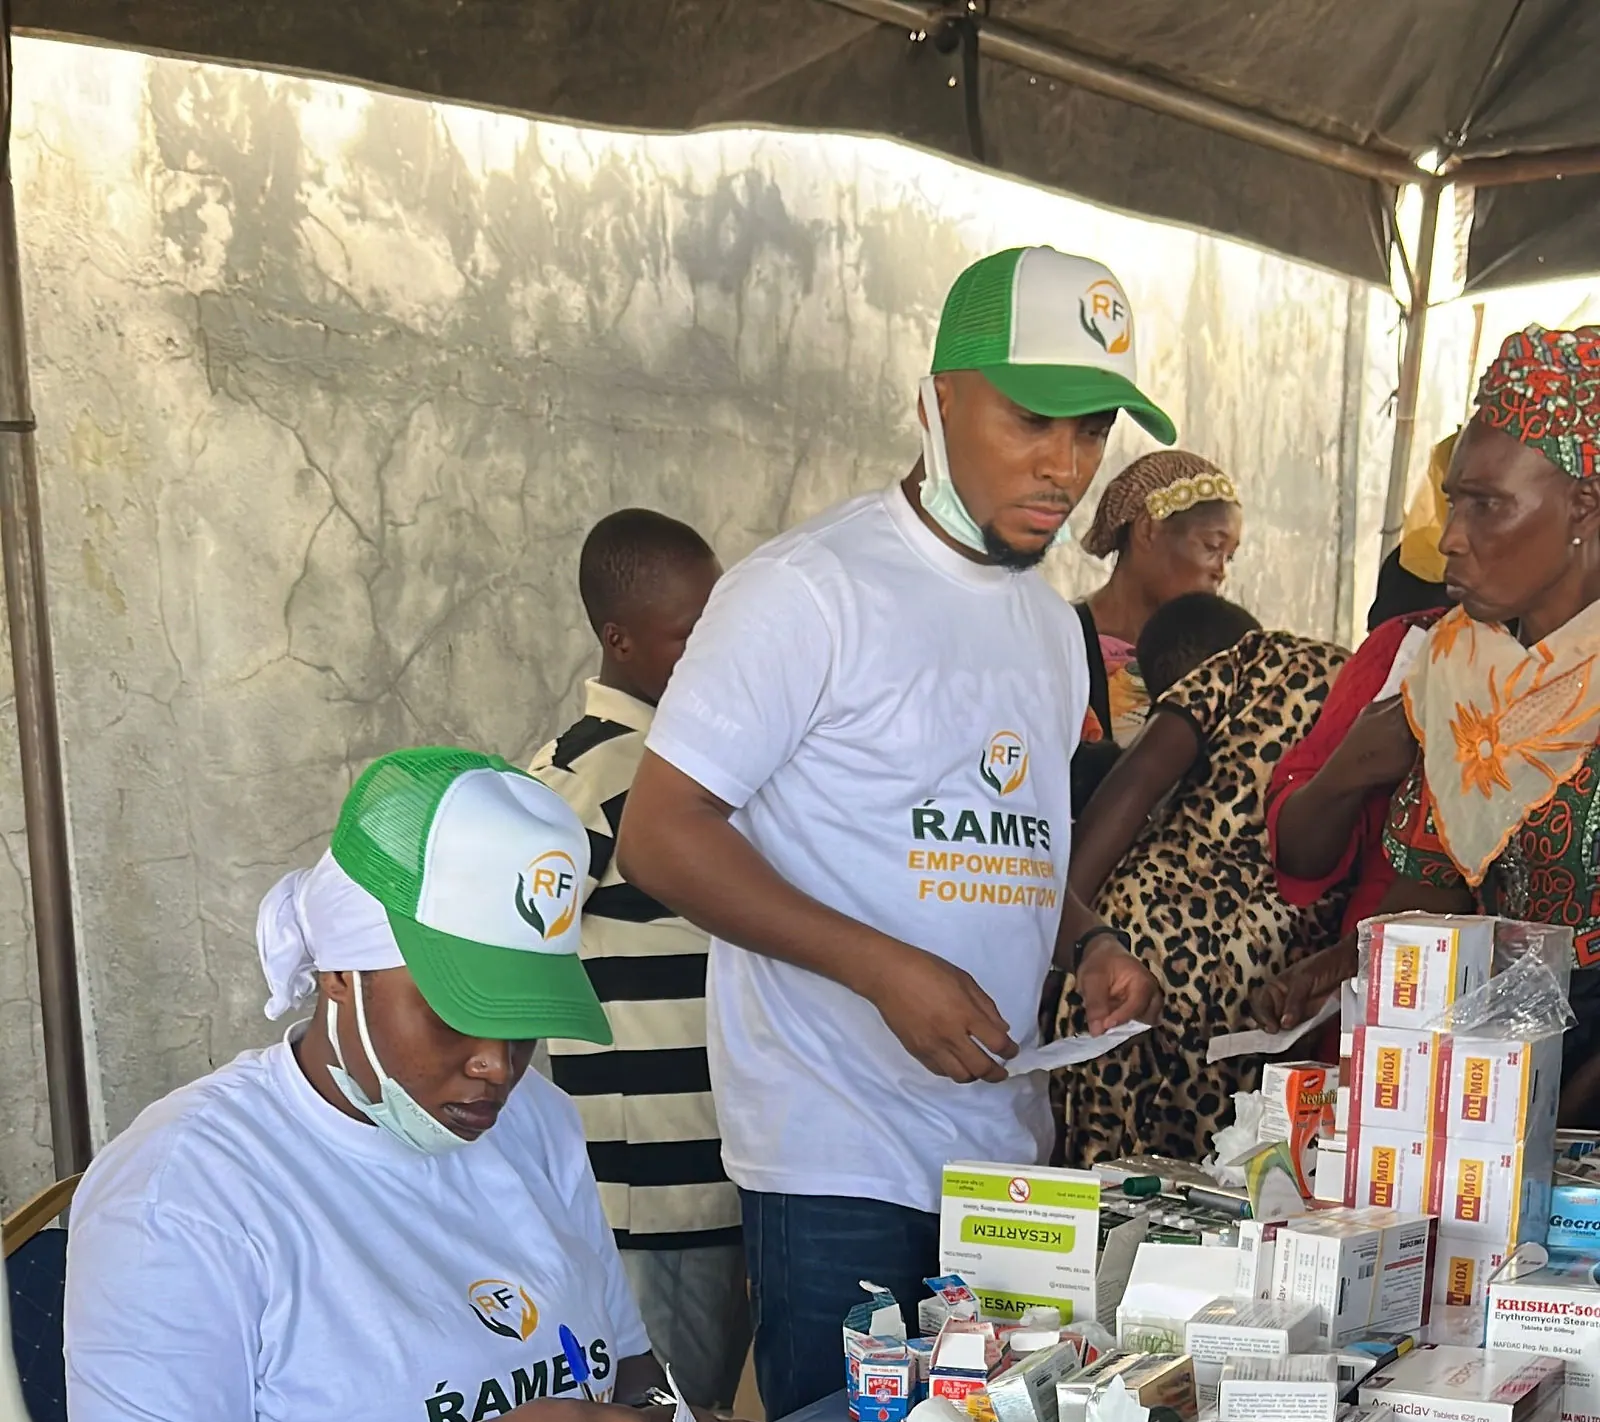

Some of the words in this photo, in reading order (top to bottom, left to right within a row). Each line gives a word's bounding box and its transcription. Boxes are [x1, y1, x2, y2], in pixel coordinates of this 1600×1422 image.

[1091, 292, 1125, 322] RF
[990, 745, 1021, 765] RF
[533, 868, 574, 899] RF
[1397, 949, 1415, 1007] OLIMOX
[1381, 1051, 1397, 1108] OLIMOX
[1468, 1062, 1485, 1119] OLIMOX
[1375, 1151, 1391, 1204] OLIMOX
[1461, 1164, 1478, 1219] OLIMOX
[973, 1224, 1062, 1245] KESARTEM
[1456, 1262, 1470, 1306] LIMOX
[477, 1286, 515, 1319] RF
[1495, 1311, 1561, 1324] Erythromycin
[1496, 1298, 1600, 1319] KRISHAT-500
